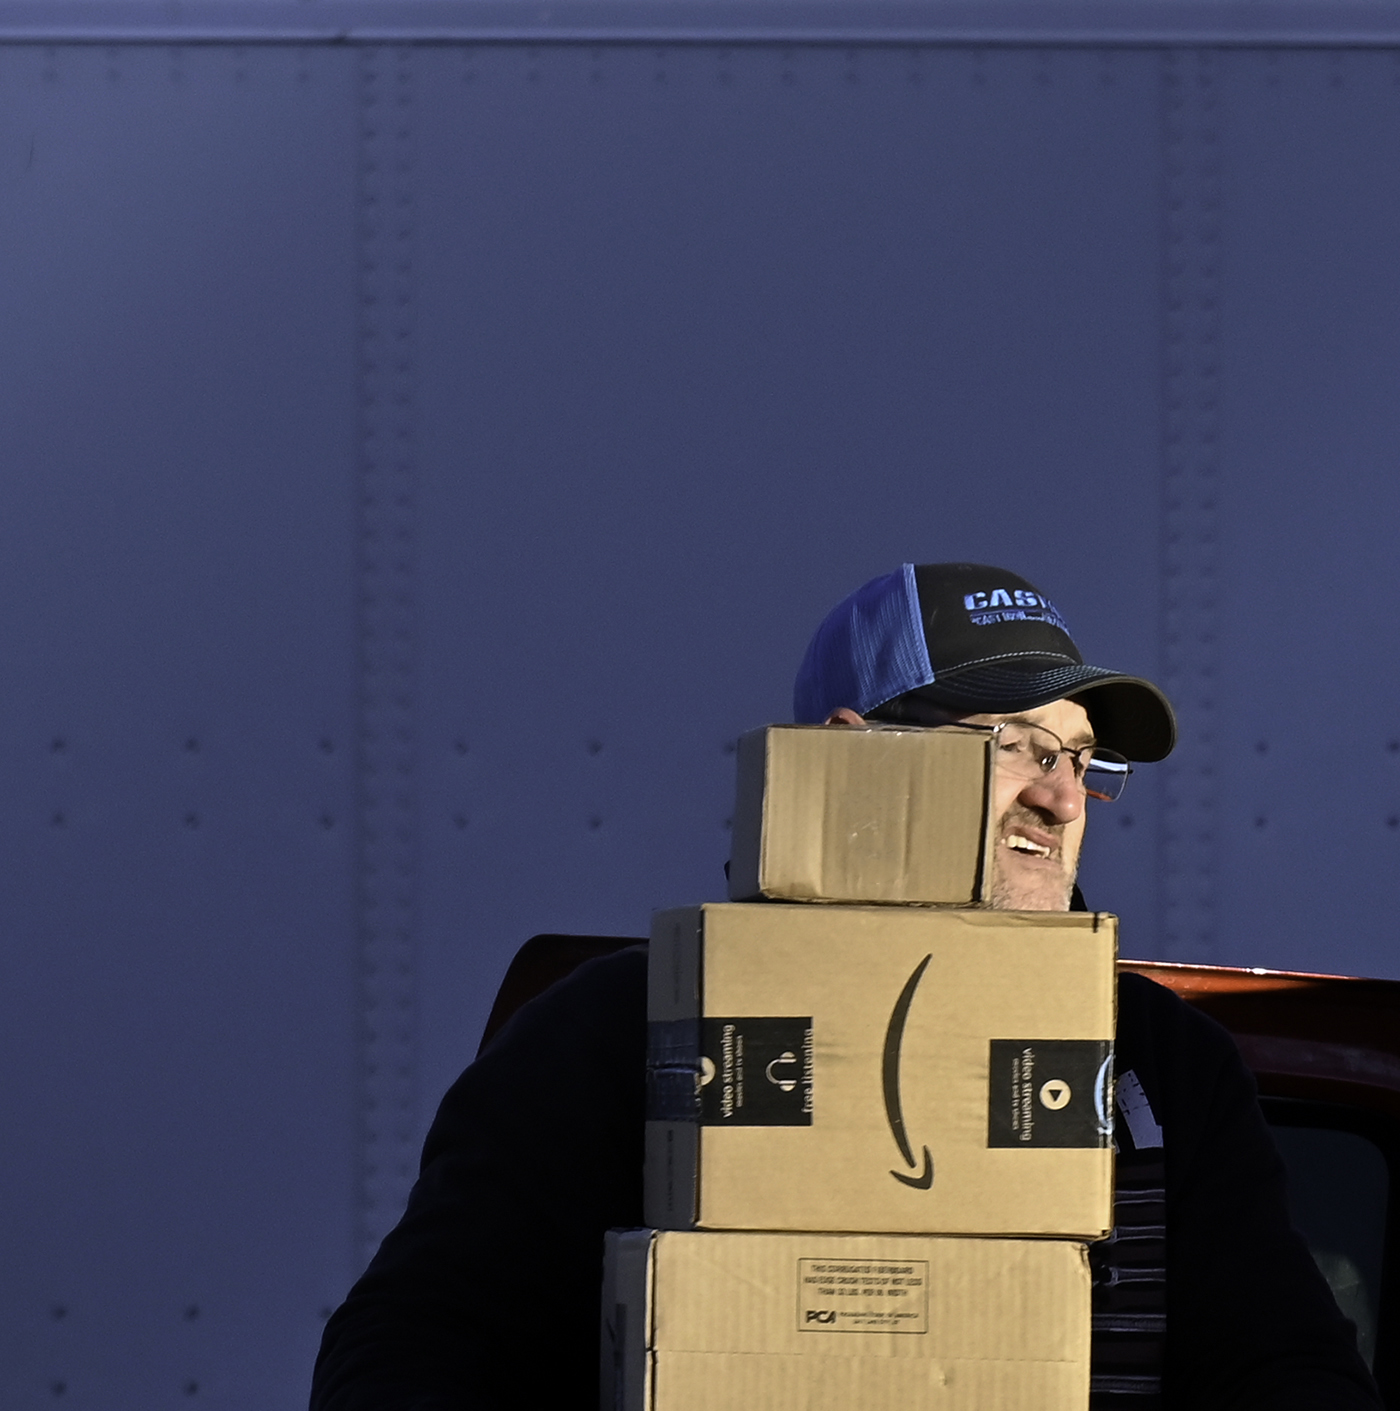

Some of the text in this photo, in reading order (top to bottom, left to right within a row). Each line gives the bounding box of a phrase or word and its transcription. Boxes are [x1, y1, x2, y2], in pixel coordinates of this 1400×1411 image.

[720, 1024, 735, 1118] video streaming
[800, 1028, 814, 1113] free listening
[1019, 1047, 1035, 1141] video streaming
[805, 1310, 836, 1324] PCA
